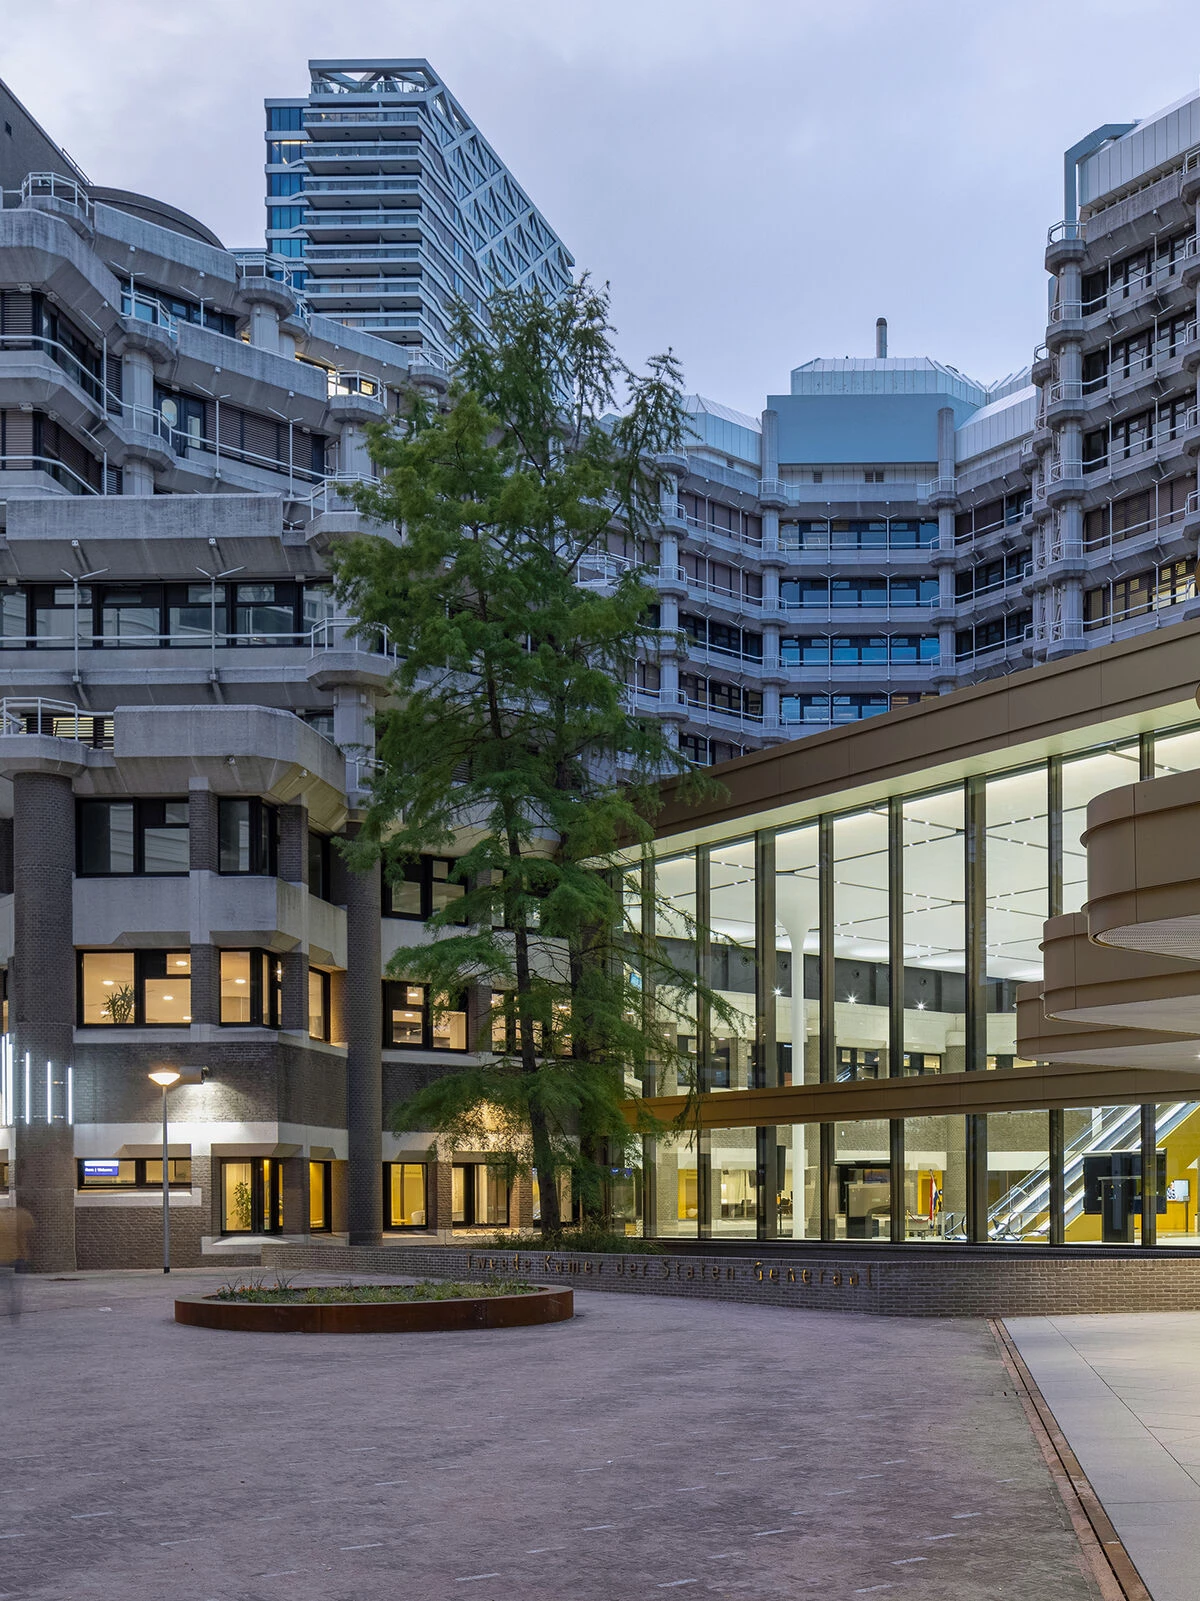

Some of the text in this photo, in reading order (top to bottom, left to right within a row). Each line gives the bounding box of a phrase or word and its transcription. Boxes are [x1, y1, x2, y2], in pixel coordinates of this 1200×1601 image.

[466, 1253, 532, 1272] Tweede
[543, 1255, 603, 1274] Kamer
[615, 1257, 648, 1277] der
